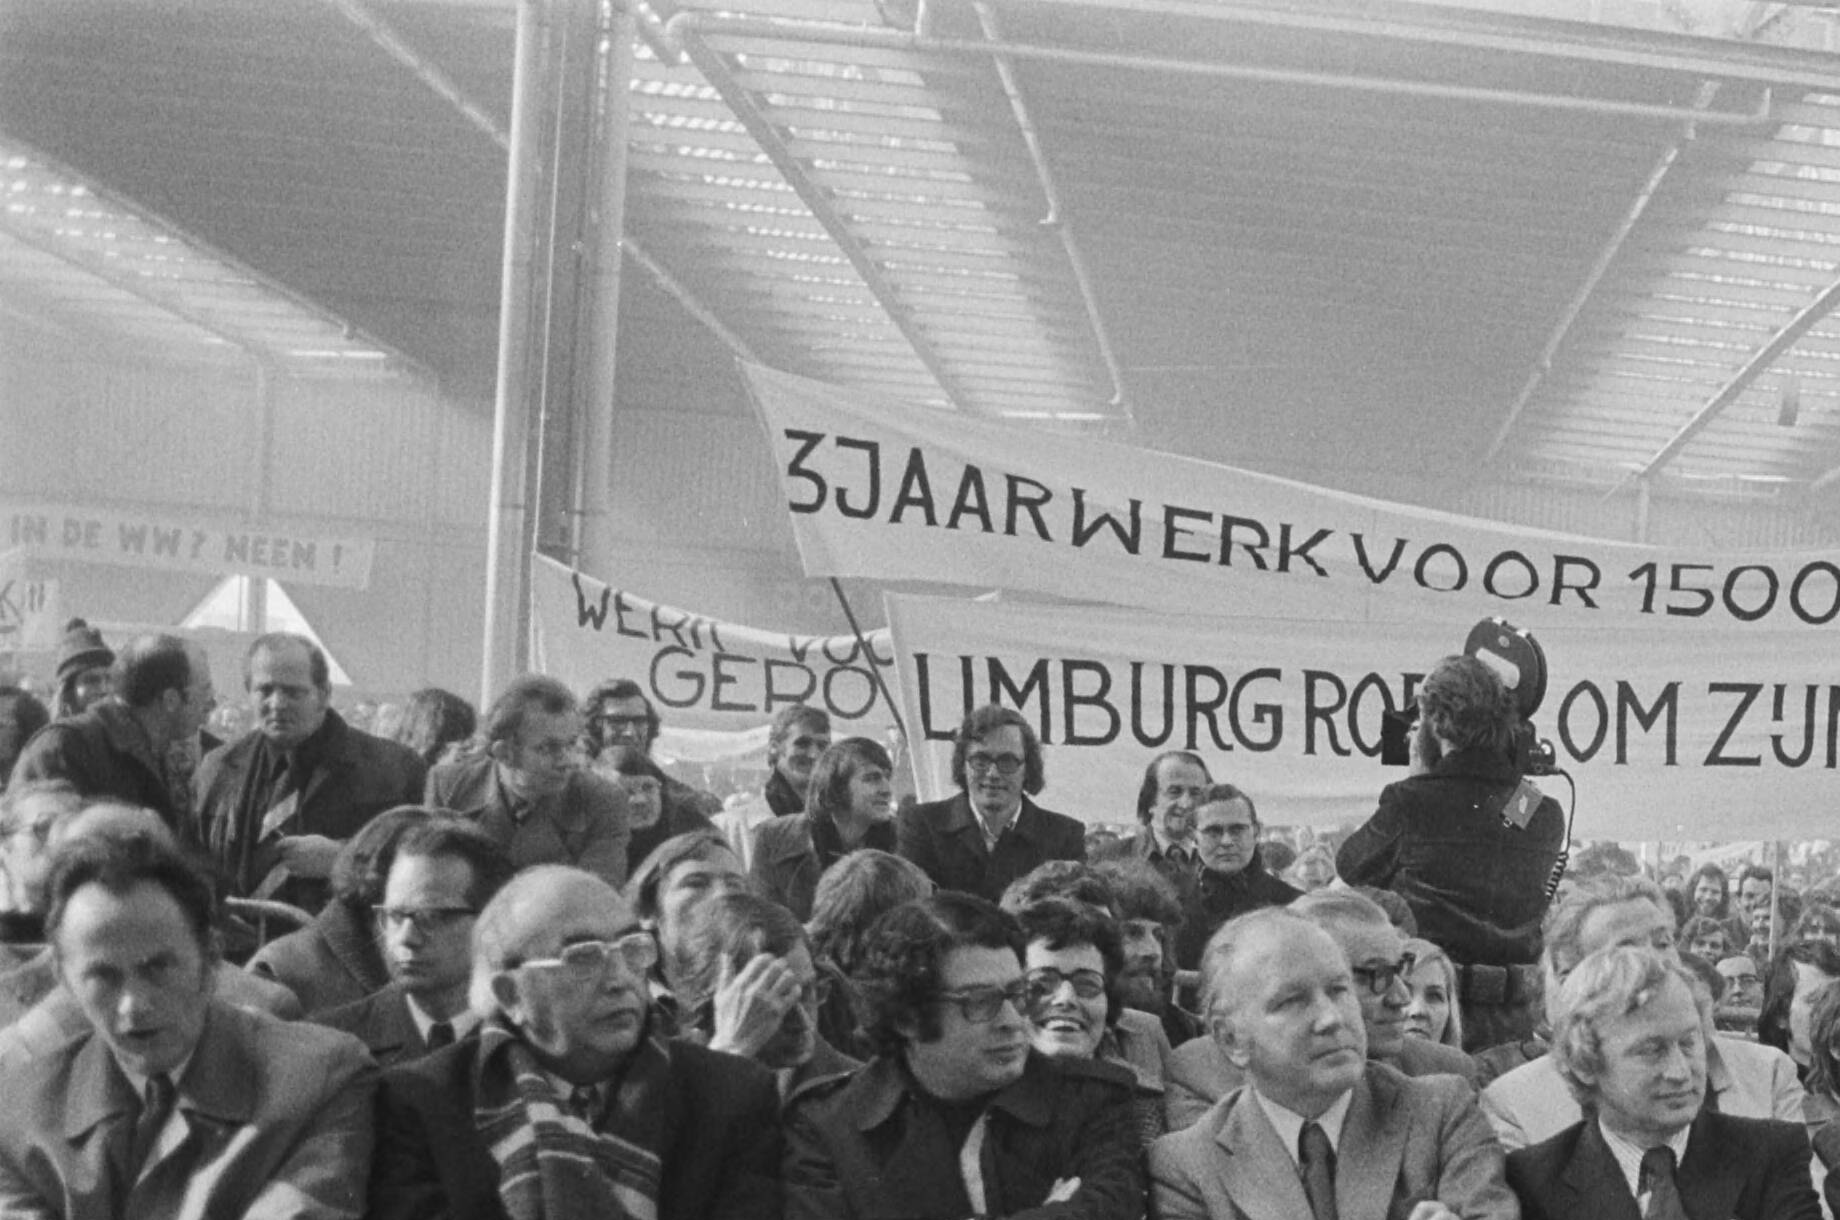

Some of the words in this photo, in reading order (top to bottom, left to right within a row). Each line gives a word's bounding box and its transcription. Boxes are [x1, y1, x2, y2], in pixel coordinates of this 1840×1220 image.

[11, 514, 48, 545] IN
[63, 518, 102, 549] DE
[223, 535, 317, 570] NEEN
[785, 428, 828, 514] 3
[835, 436, 1054, 542] JAAR
[1071, 487, 1335, 577] WERK
[1350, 532, 1602, 609] VOOR
[913, 652, 1284, 752] LIMBURG
[1558, 679, 1683, 766] OM
